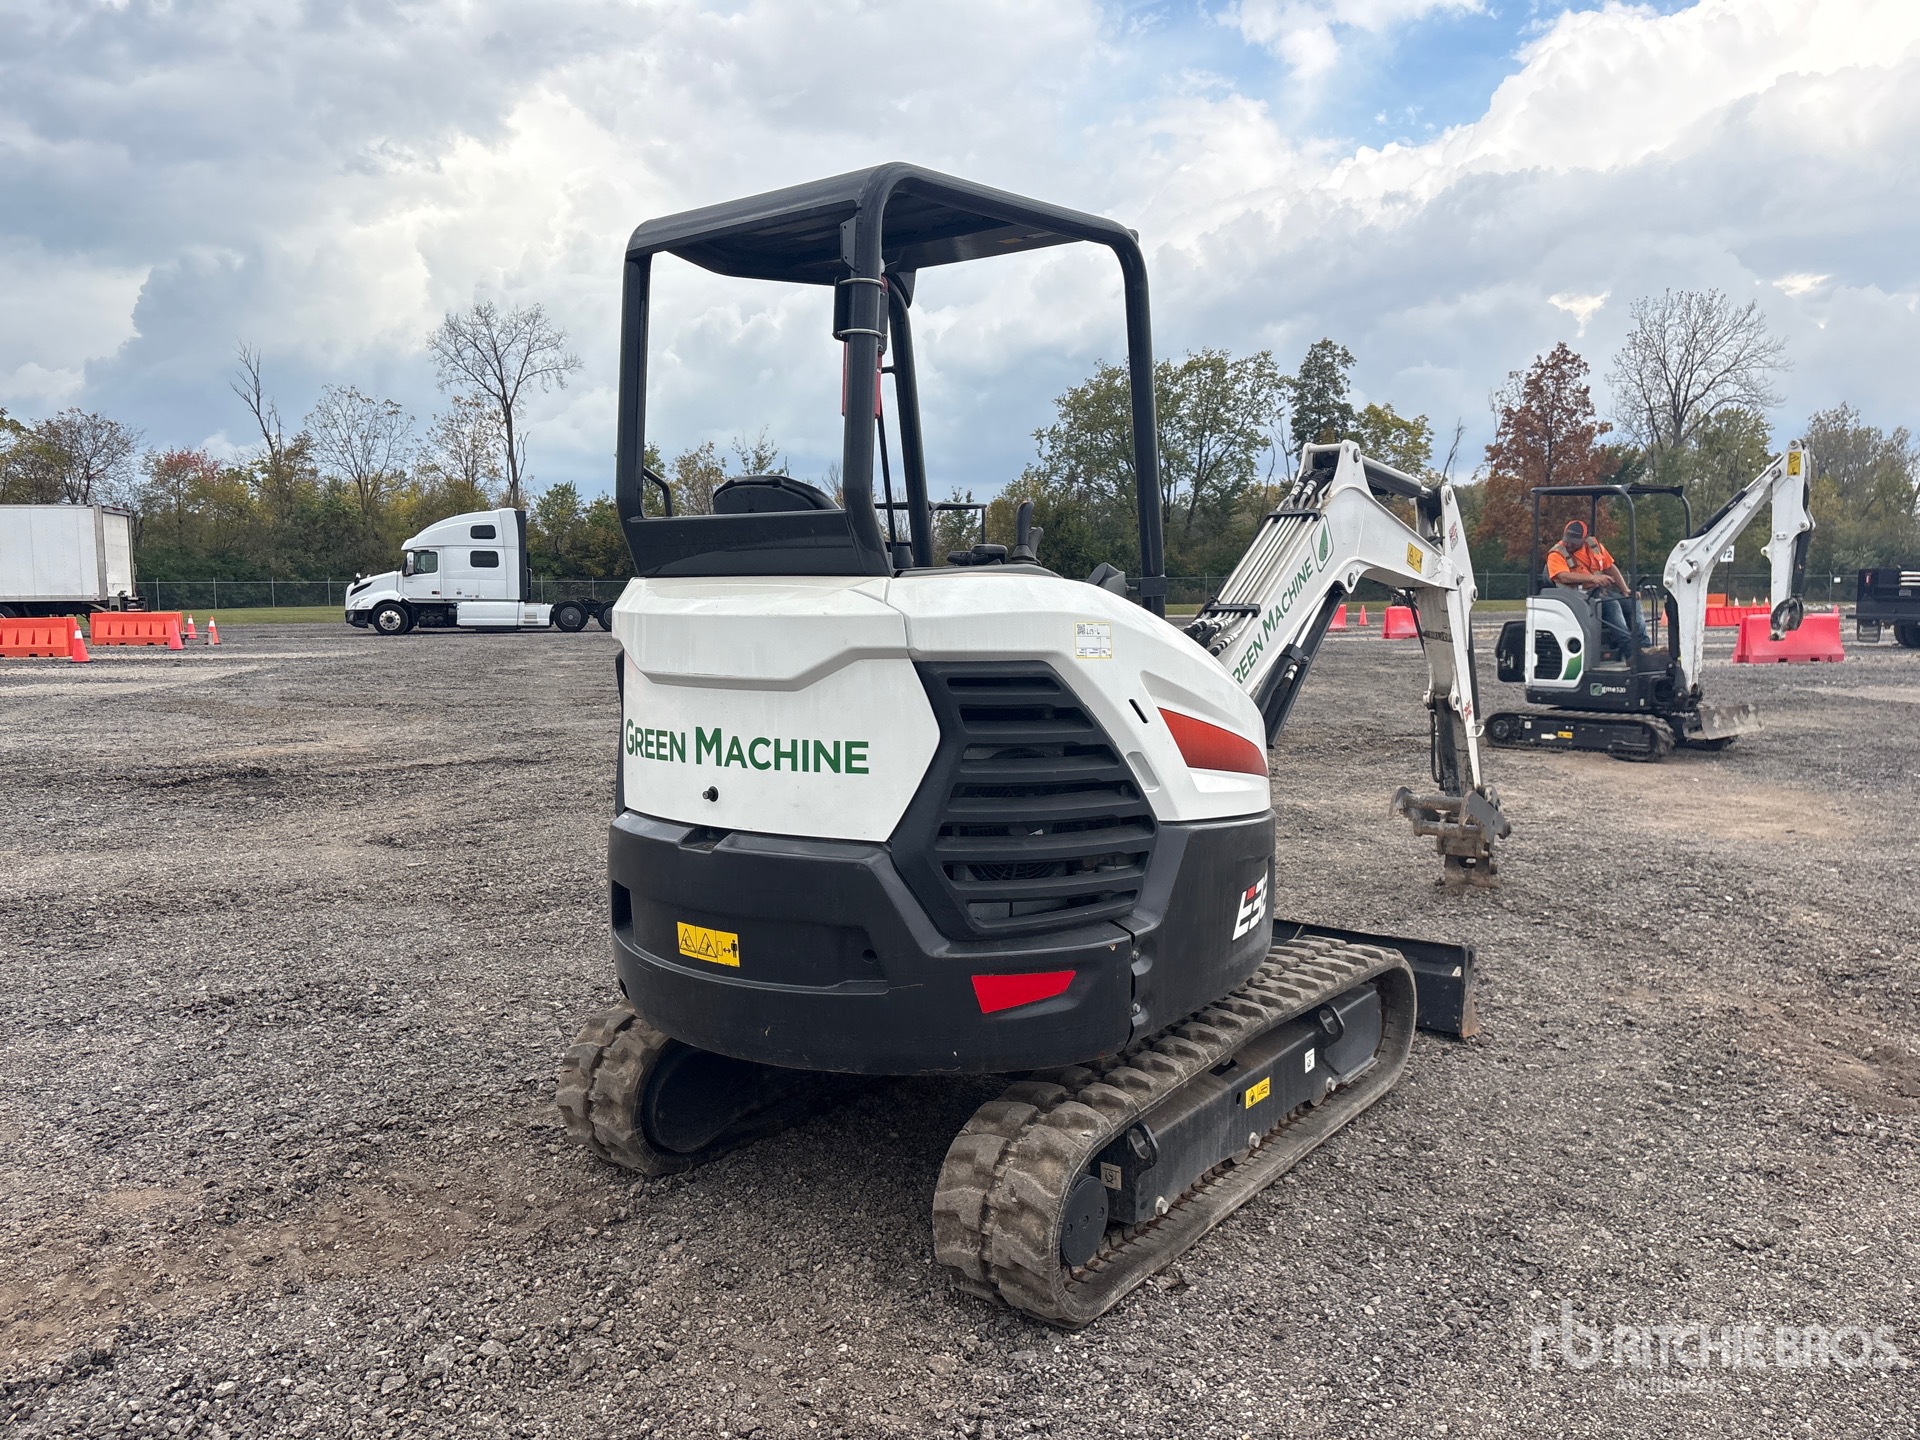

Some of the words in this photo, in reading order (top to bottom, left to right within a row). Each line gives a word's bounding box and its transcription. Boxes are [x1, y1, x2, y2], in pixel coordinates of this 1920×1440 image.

[1231, 633, 1264, 685] REEN
[1262, 557, 1313, 642] MACHINE
[625, 718, 686, 763] GREEN
[695, 726, 869, 774] MACHINE
